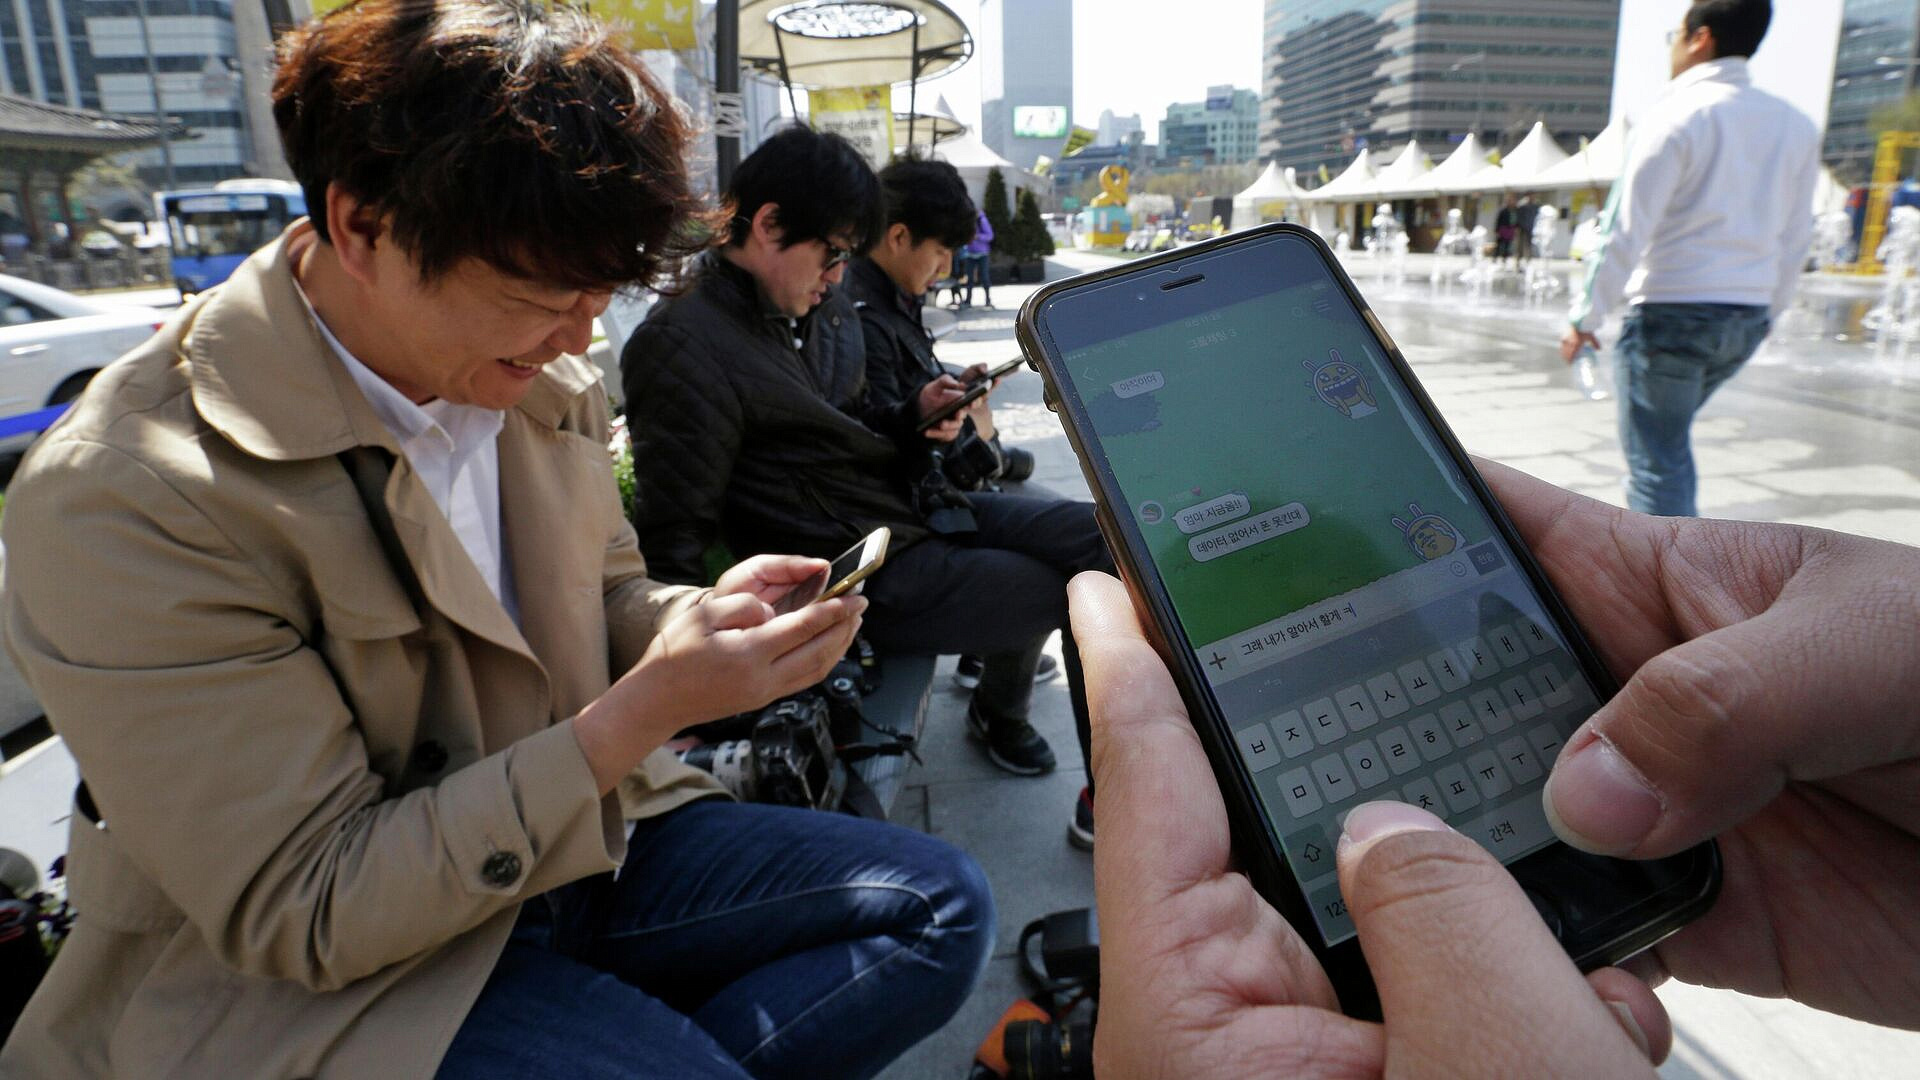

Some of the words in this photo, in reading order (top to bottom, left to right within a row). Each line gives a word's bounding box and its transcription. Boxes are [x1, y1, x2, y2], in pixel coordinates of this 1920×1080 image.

[1183, 511, 1205, 526] 엄마
[1196, 533, 1228, 553] 데이터
[1227, 523, 1260, 545] 없어서
[1240, 638, 1264, 656] 그래
[1264, 630, 1287, 648] 내가
[1286, 618, 1320, 640] 알아서
[1319, 609, 1342, 627] 할게
[1488, 820, 1516, 844] 간격
